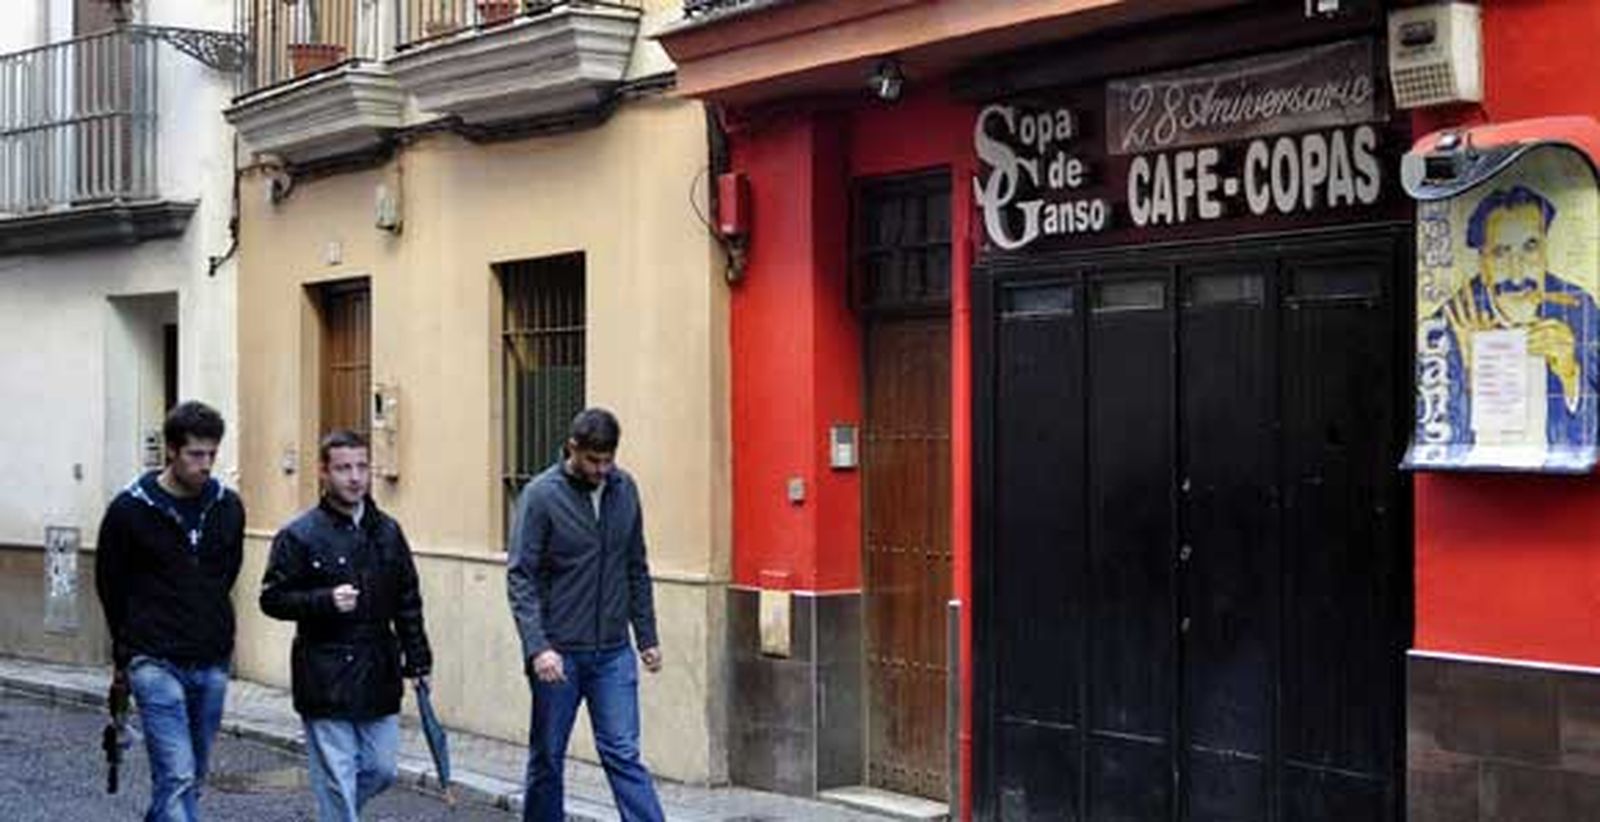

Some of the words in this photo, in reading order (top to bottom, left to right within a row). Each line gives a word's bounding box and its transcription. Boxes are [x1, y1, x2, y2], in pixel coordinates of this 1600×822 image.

[973, 105, 1072, 206] Sopa
[1121, 83, 1184, 150] 28
[984, 157, 1104, 249] Ganso
[1048, 151, 1082, 189] de
